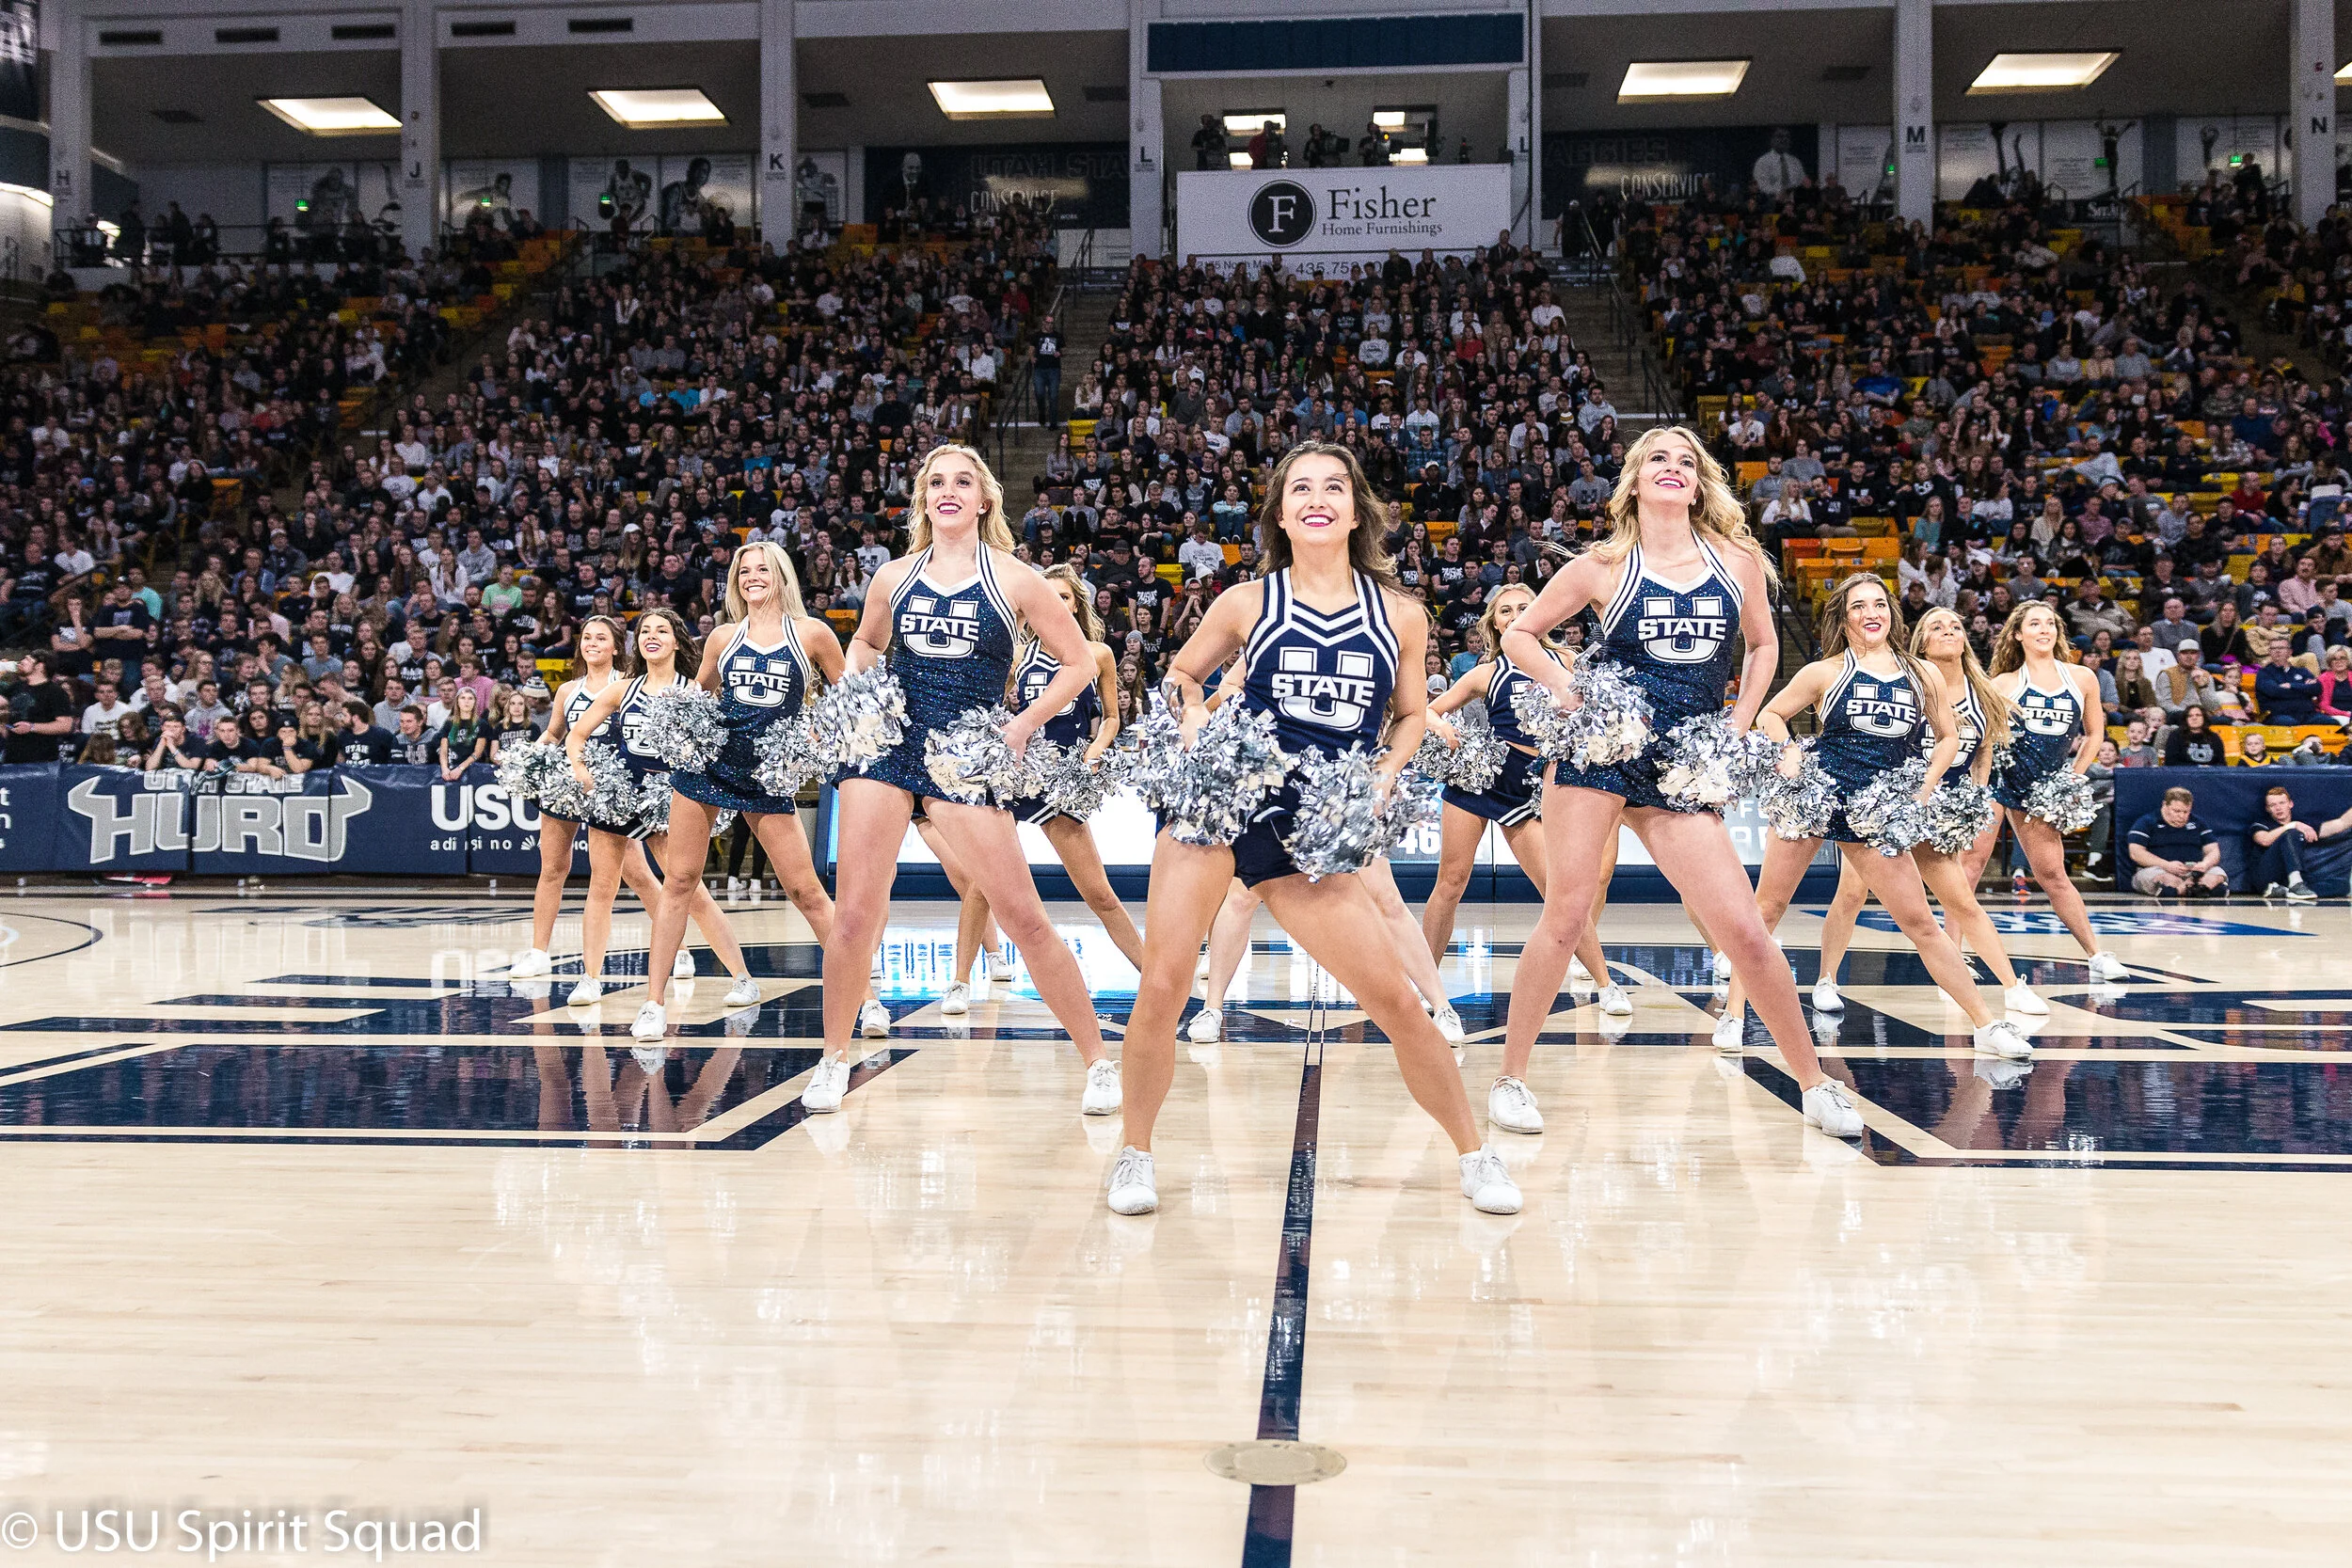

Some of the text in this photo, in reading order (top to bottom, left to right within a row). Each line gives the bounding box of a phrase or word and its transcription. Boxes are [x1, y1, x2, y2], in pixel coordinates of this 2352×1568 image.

[1906, 126, 1926, 143] M
[2312, 118, 2328, 134] N
[769, 153, 784, 171] K
[1139, 146, 1152, 163] L
[408, 160, 421, 179] J
[1067, 151, 1129, 179] STA
[55, 169, 70, 186] H
[1267, 185, 1437, 232] F Fisher
[1322, 220, 1443, 236] Home Furnishings
[899, 612, 980, 642] STATE
[1637, 617, 1727, 641] STATE
[728, 670, 791, 693] STATE
[1271, 673, 1375, 707] STATE
[1846, 698, 1917, 724] STATE
[2023, 707, 2074, 724] STATE
[344, 745, 370, 754] UTAH
[68, 774, 373, 863] HURD
